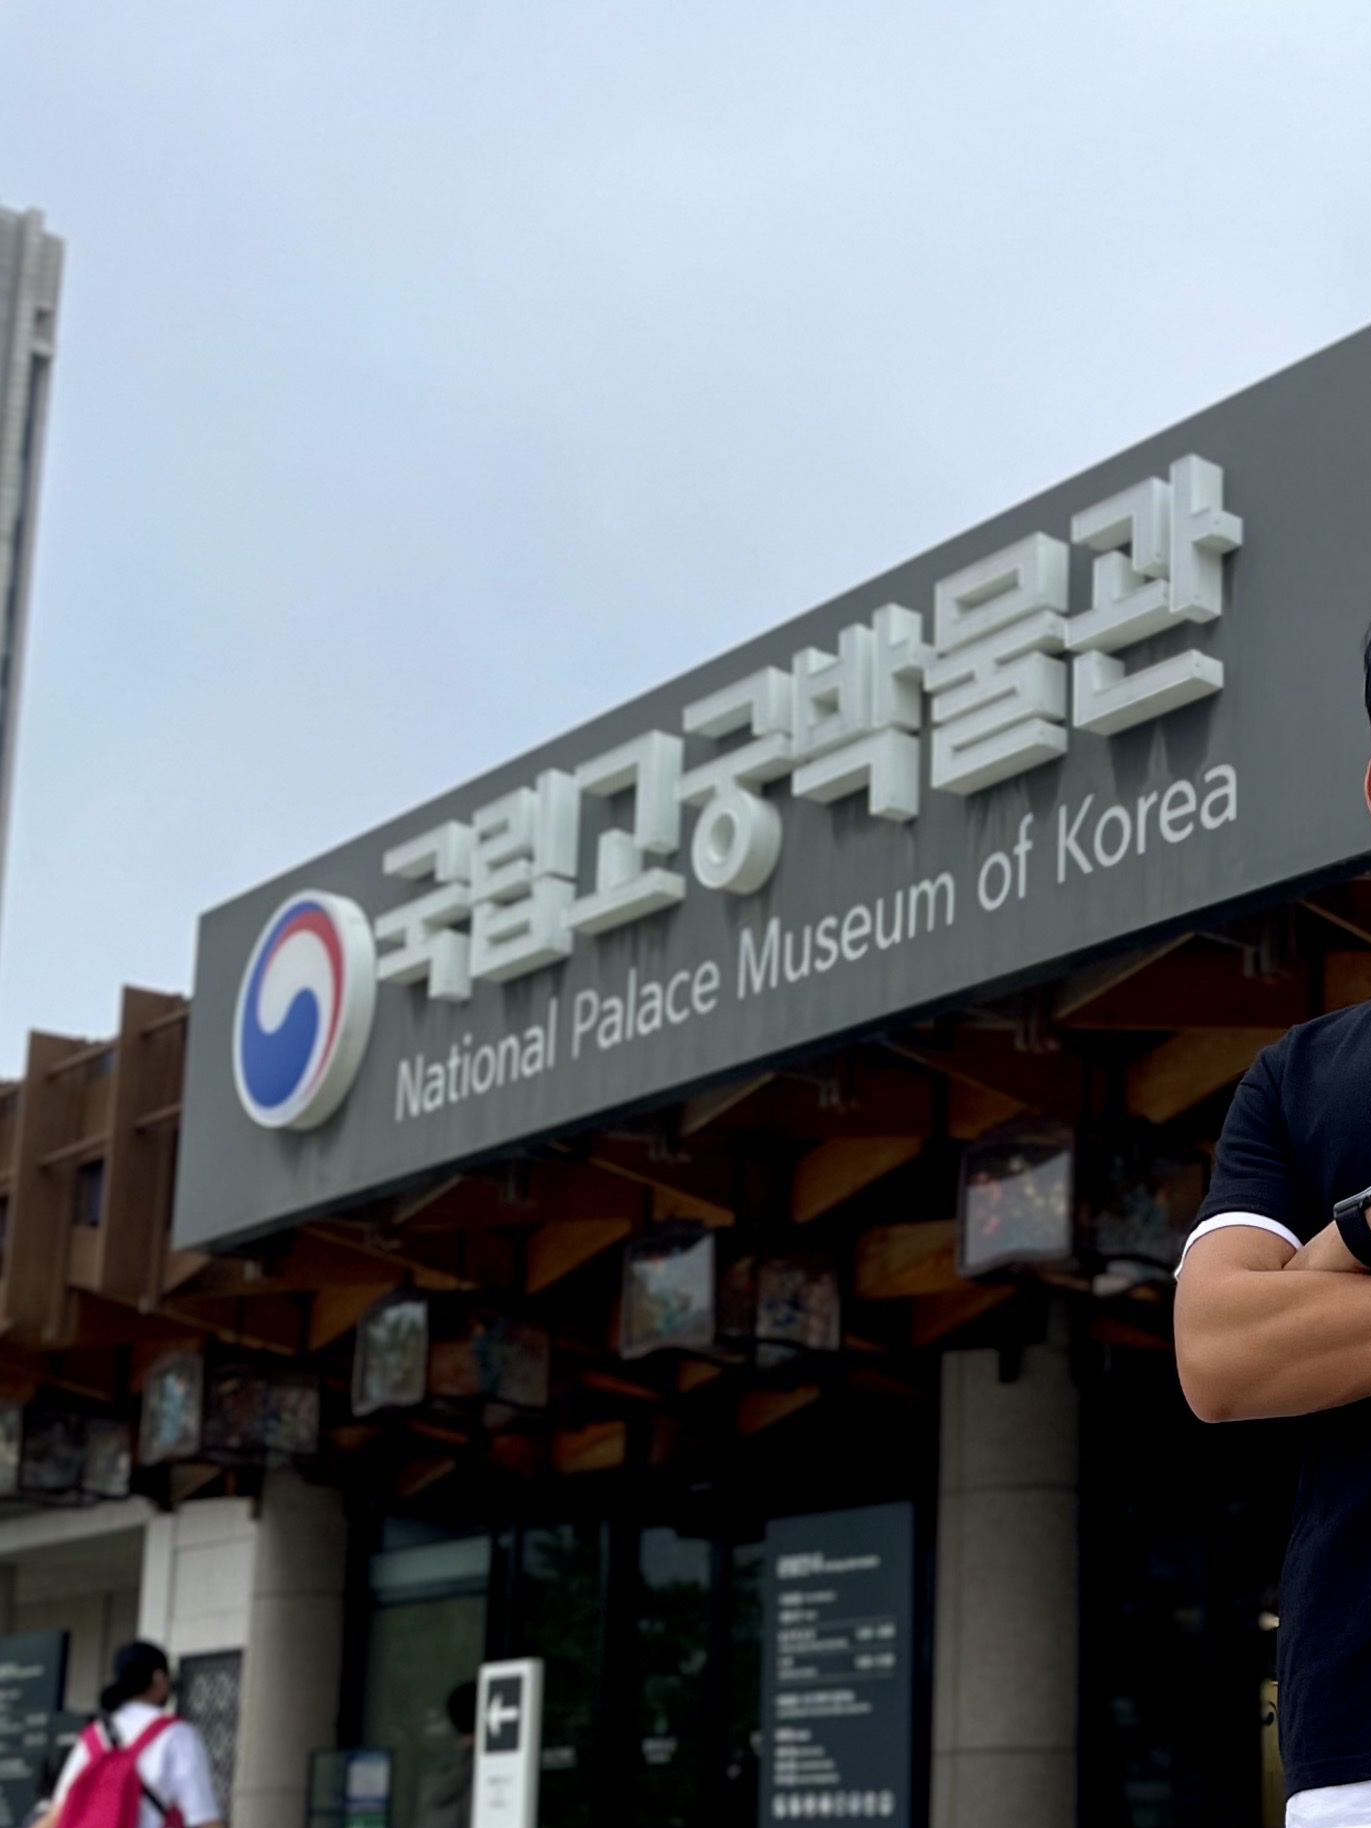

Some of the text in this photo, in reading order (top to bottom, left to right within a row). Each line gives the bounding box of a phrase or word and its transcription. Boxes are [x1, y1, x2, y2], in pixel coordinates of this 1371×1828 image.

[374, 453, 1243, 1001] 국립고궁박물관
[395, 763, 1239, 1123] National Palace Museum of Korea
